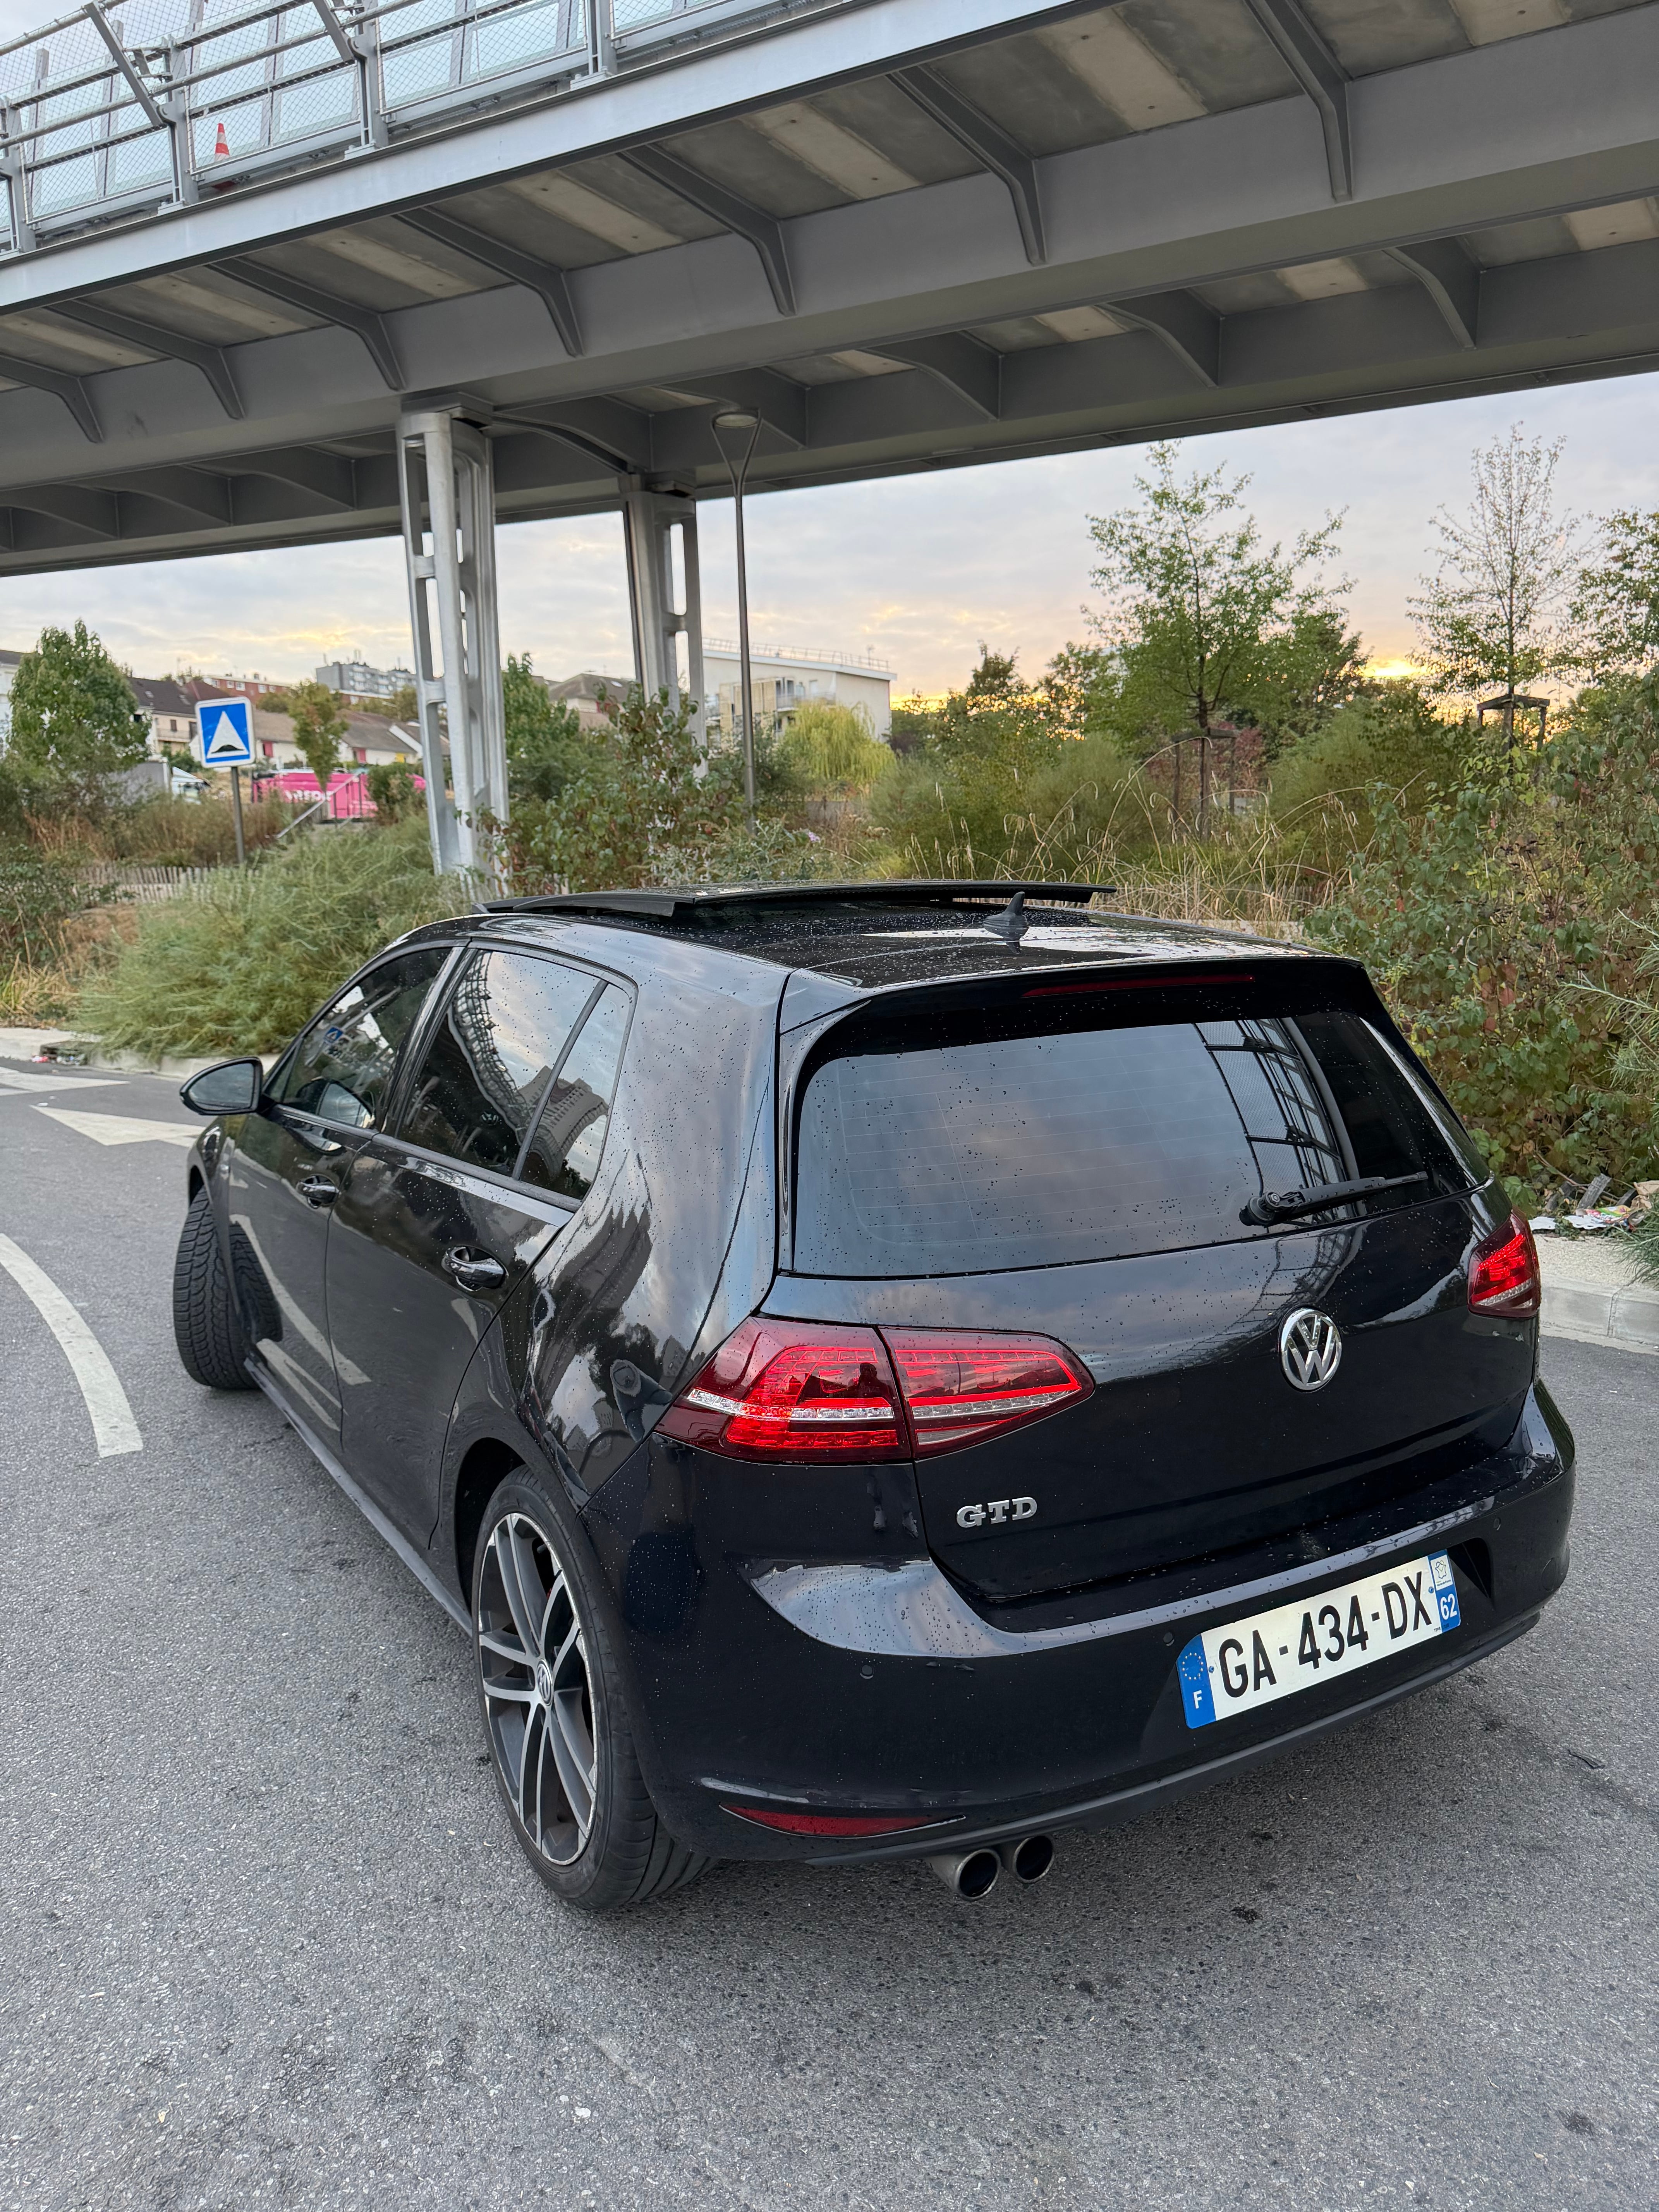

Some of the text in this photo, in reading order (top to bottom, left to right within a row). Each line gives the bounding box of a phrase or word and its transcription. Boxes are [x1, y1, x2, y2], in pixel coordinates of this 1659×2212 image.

[1281, 1309, 1342, 1390] VW
[957, 1497, 1037, 1528] GTD
[1440, 1594, 1457, 1620] 62
[1219, 1571, 1432, 1698] GA-434-DX
[1193, 1690, 1202, 1709] F
